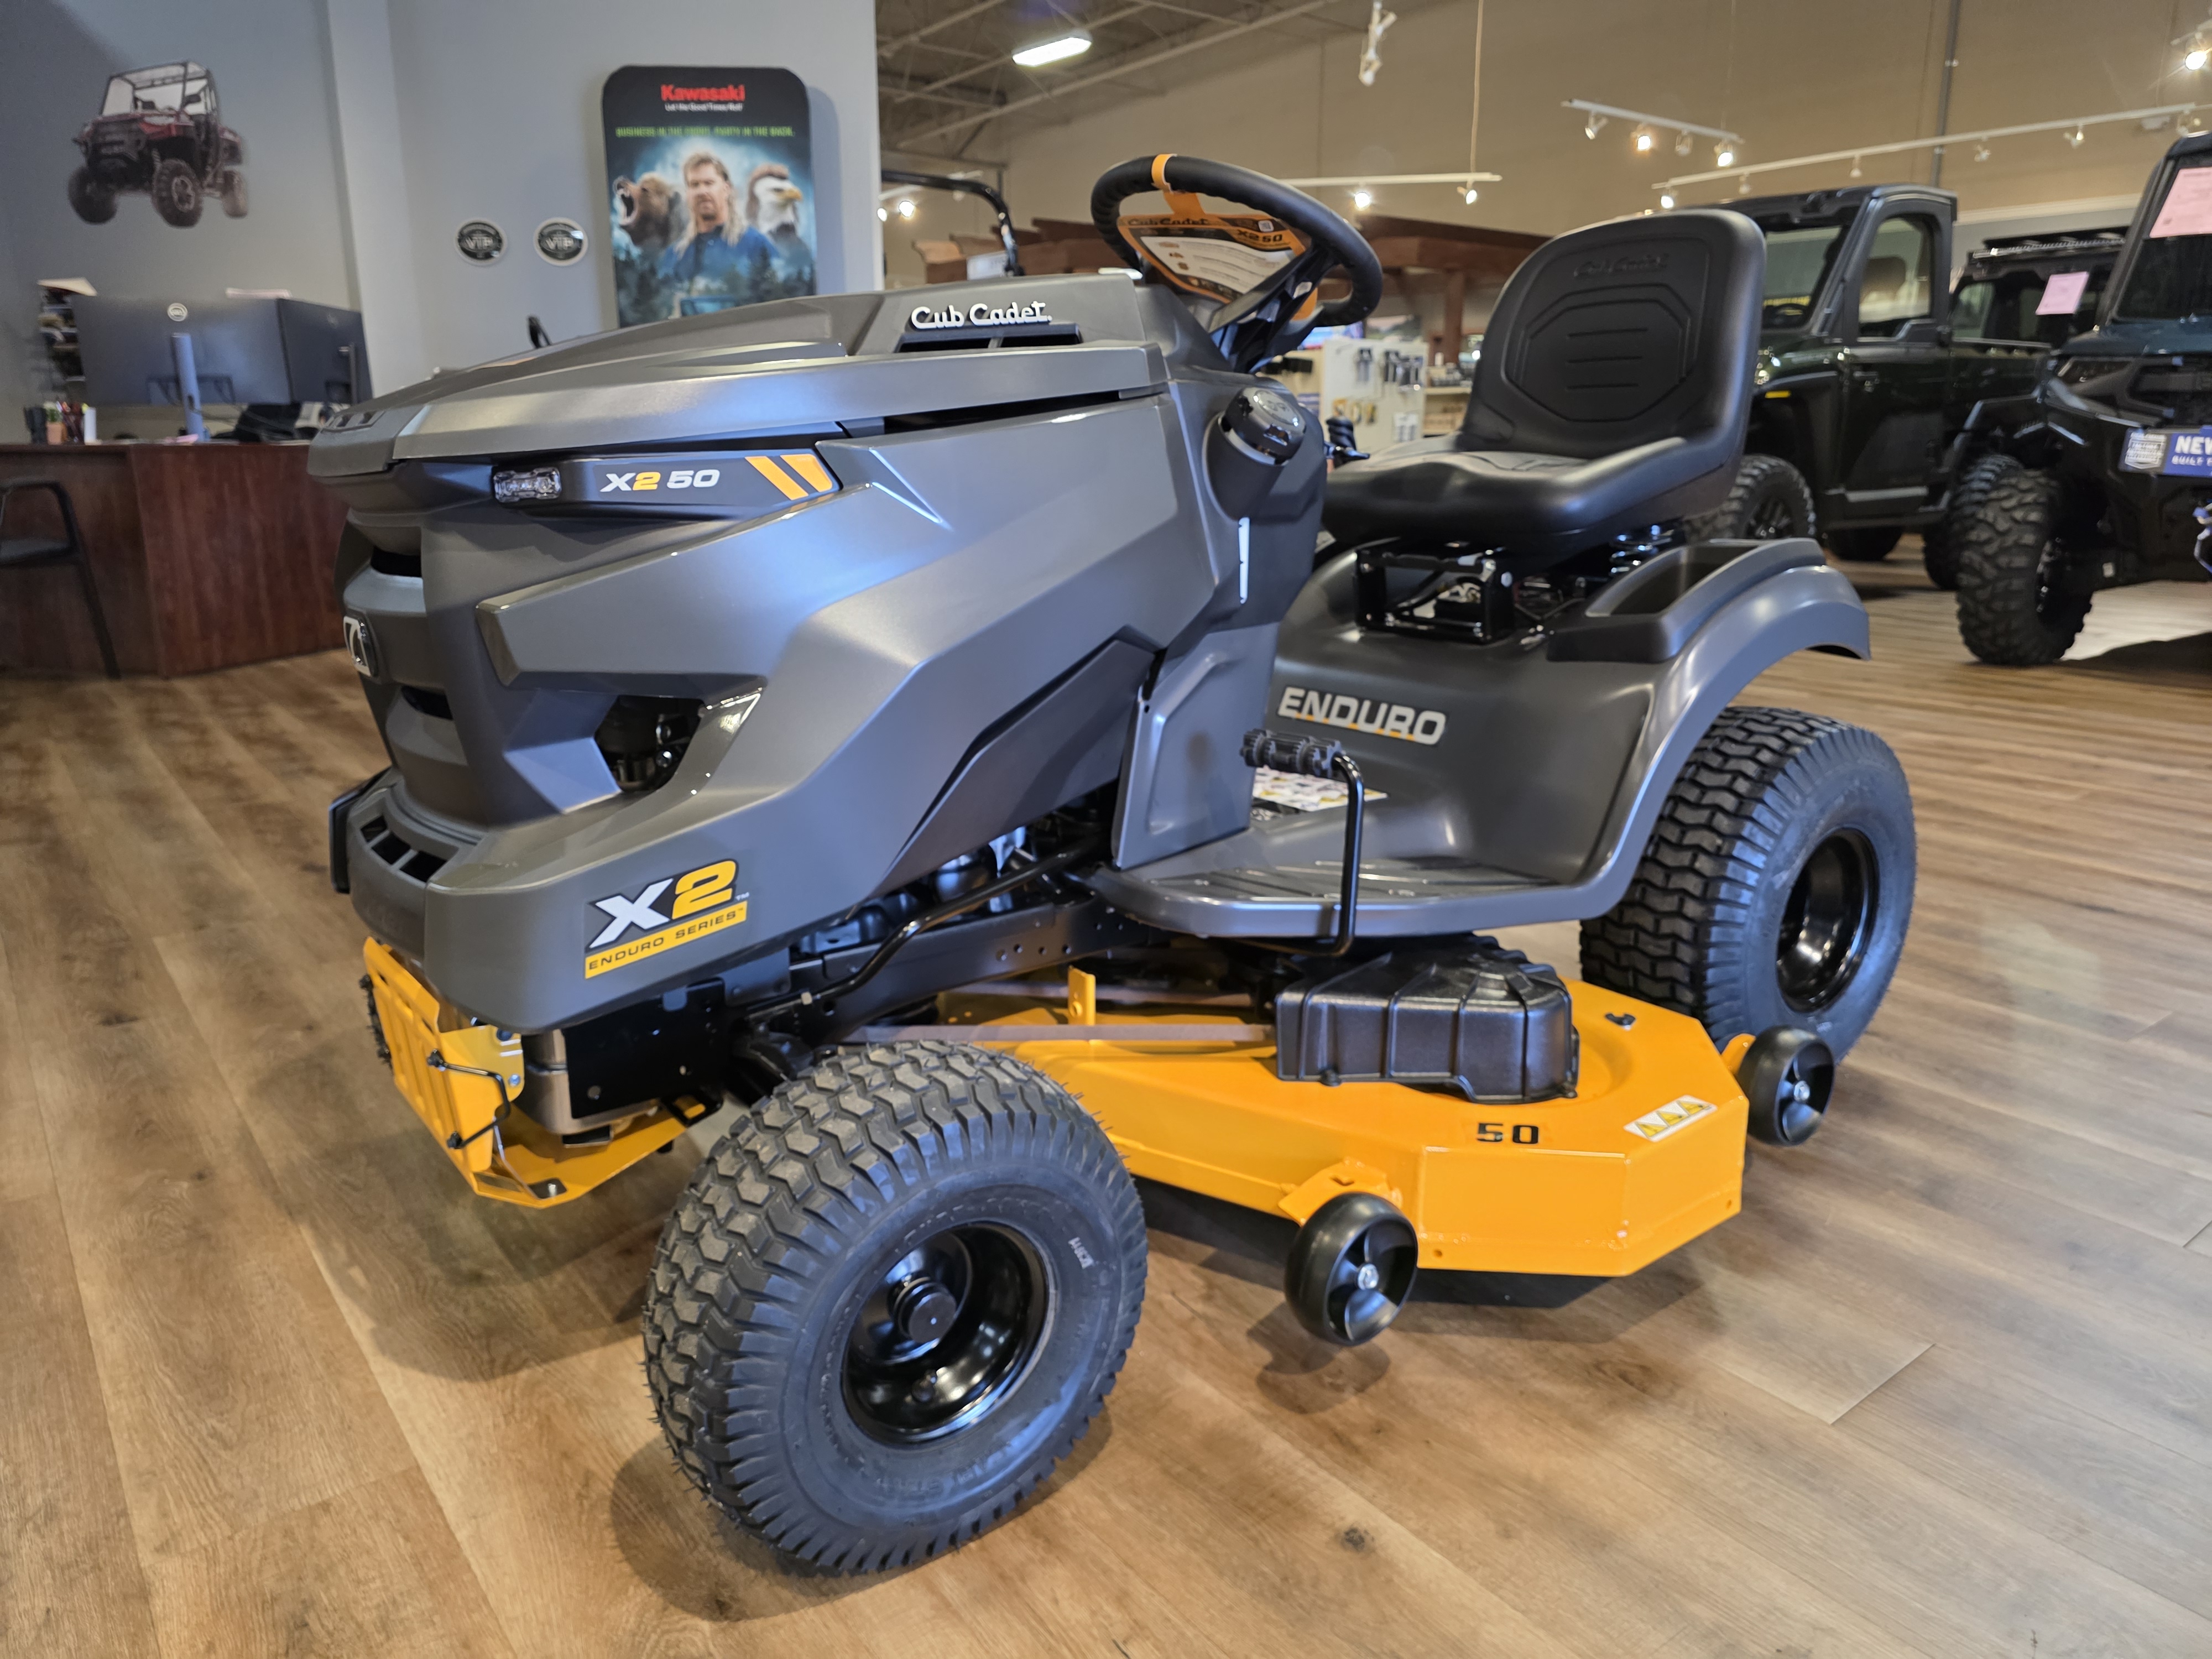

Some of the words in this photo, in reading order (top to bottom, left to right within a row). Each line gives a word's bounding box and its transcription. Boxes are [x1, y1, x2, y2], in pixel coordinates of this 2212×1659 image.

[661, 84, 745, 101] Kawasaki
[911, 305, 965, 330] Cub
[969, 300, 1052, 326] Cadet
[600, 471, 661, 492] X2
[666, 469, 720, 489] 50
[1277, 686, 1447, 745] ENDURO
[589, 859, 737, 949] X2
[588, 936, 665, 971] ENDURO
[1476, 1121, 1540, 1145] 50
